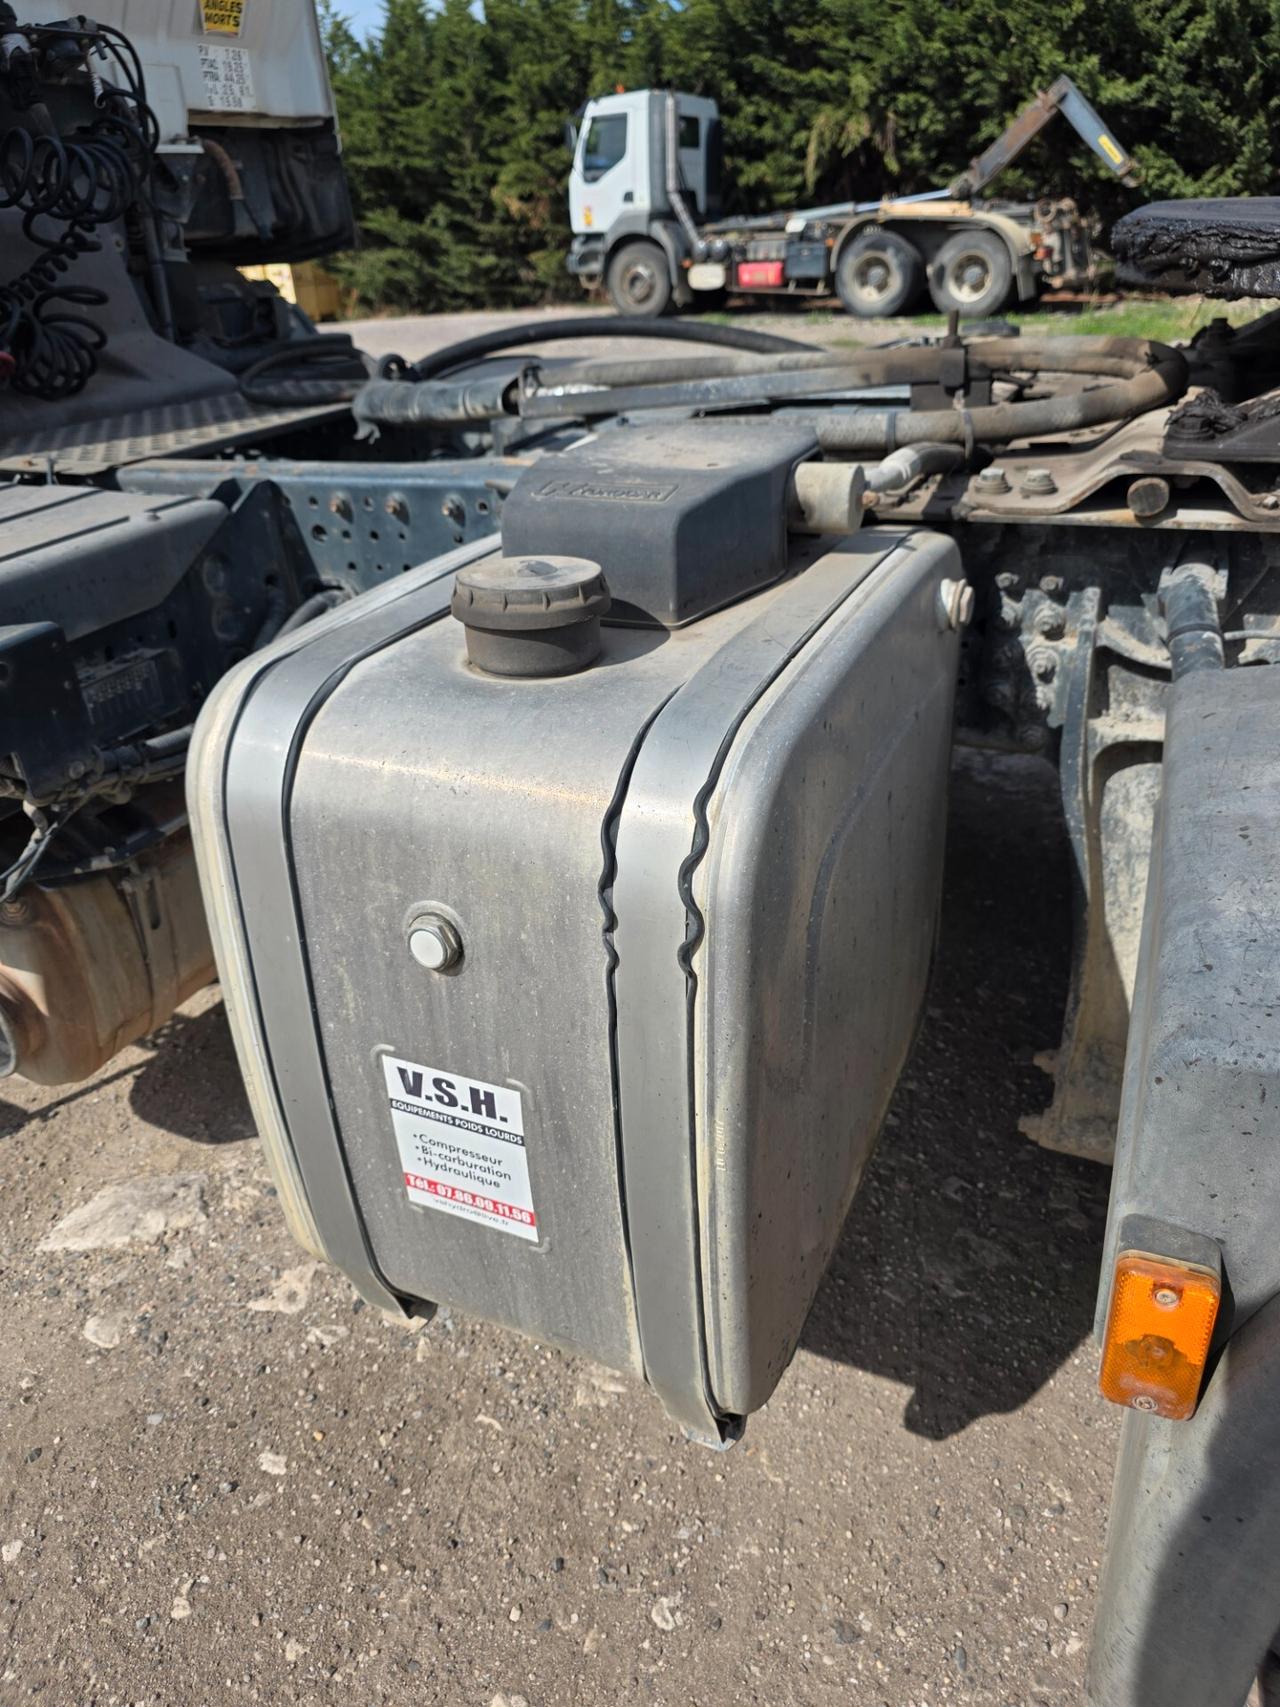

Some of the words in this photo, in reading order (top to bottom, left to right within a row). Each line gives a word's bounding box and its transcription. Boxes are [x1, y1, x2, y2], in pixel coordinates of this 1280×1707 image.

[203, 0, 242, 14] ANGLES
[204, 12, 240, 27] MORTS
[397, 1066, 508, 1123] V.S.H.
[391, 1099, 453, 1124] EQUIPEMENTS
[455, 1117, 483, 1133] POIDS
[485, 1126, 524, 1145] LOURDS
[418, 1133, 503, 1167] Compresseur
[421, 1145, 512, 1181] Bi-carburation
[423, 1156, 501, 1188] Hydraulique
